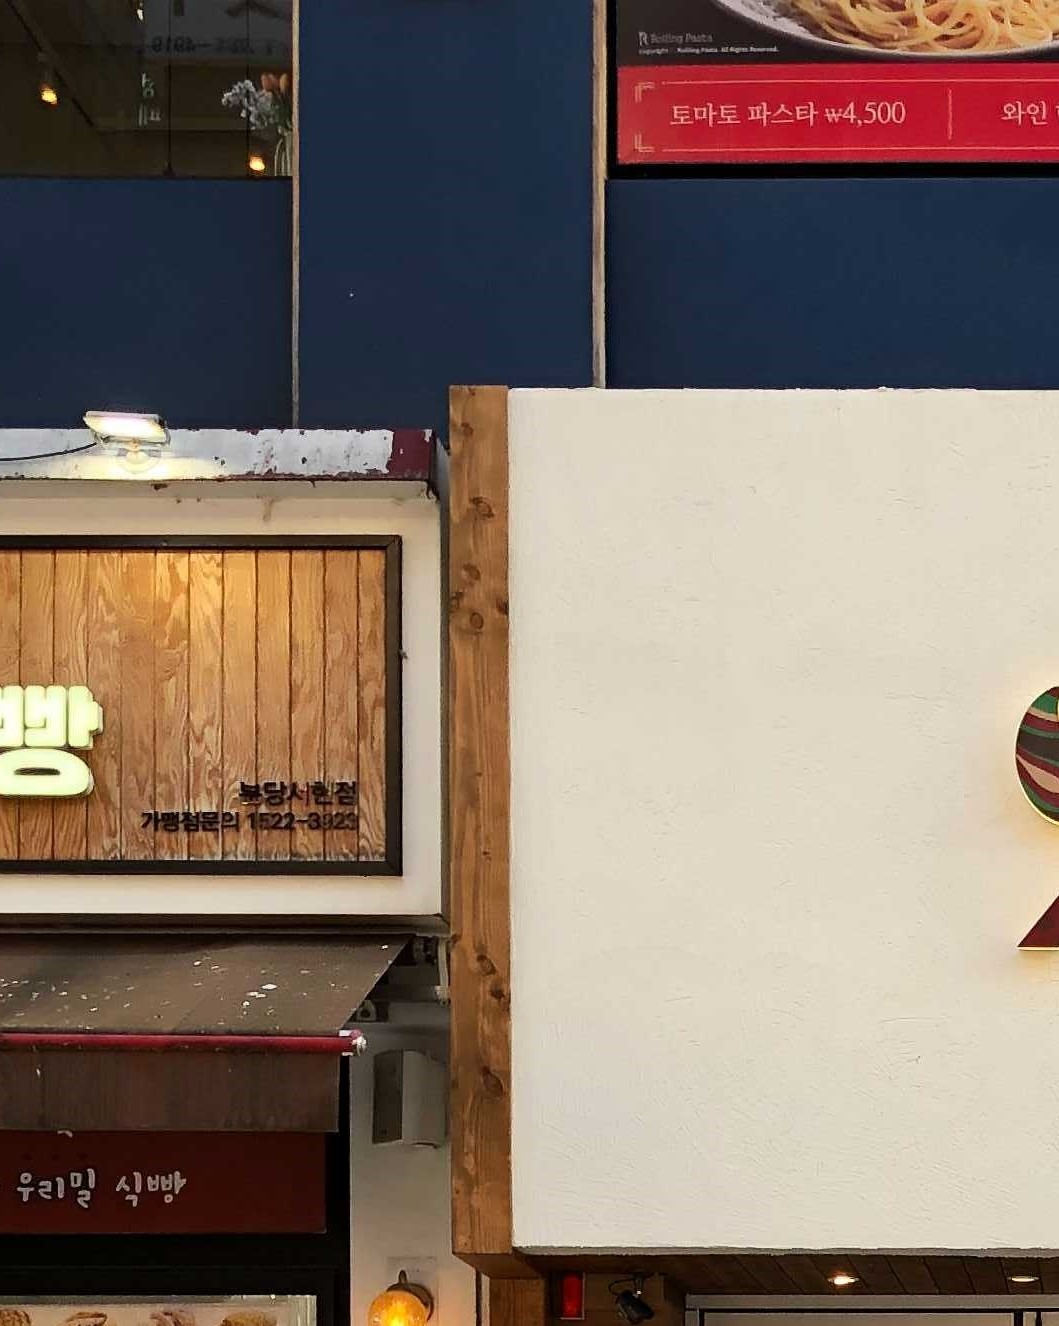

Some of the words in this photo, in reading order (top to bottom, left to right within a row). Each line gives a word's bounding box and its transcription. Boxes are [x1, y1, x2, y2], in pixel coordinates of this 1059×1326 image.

[670, 103, 737, 128] 토마토
[748, 103, 819, 128] 파스타
[1001, 102, 1048, 128] 와인
[141, 810, 240, 832] 가맹점문의
[17, 1168, 96, 1209] 우리밀
[116, 1170, 187, 1207] 식빵
